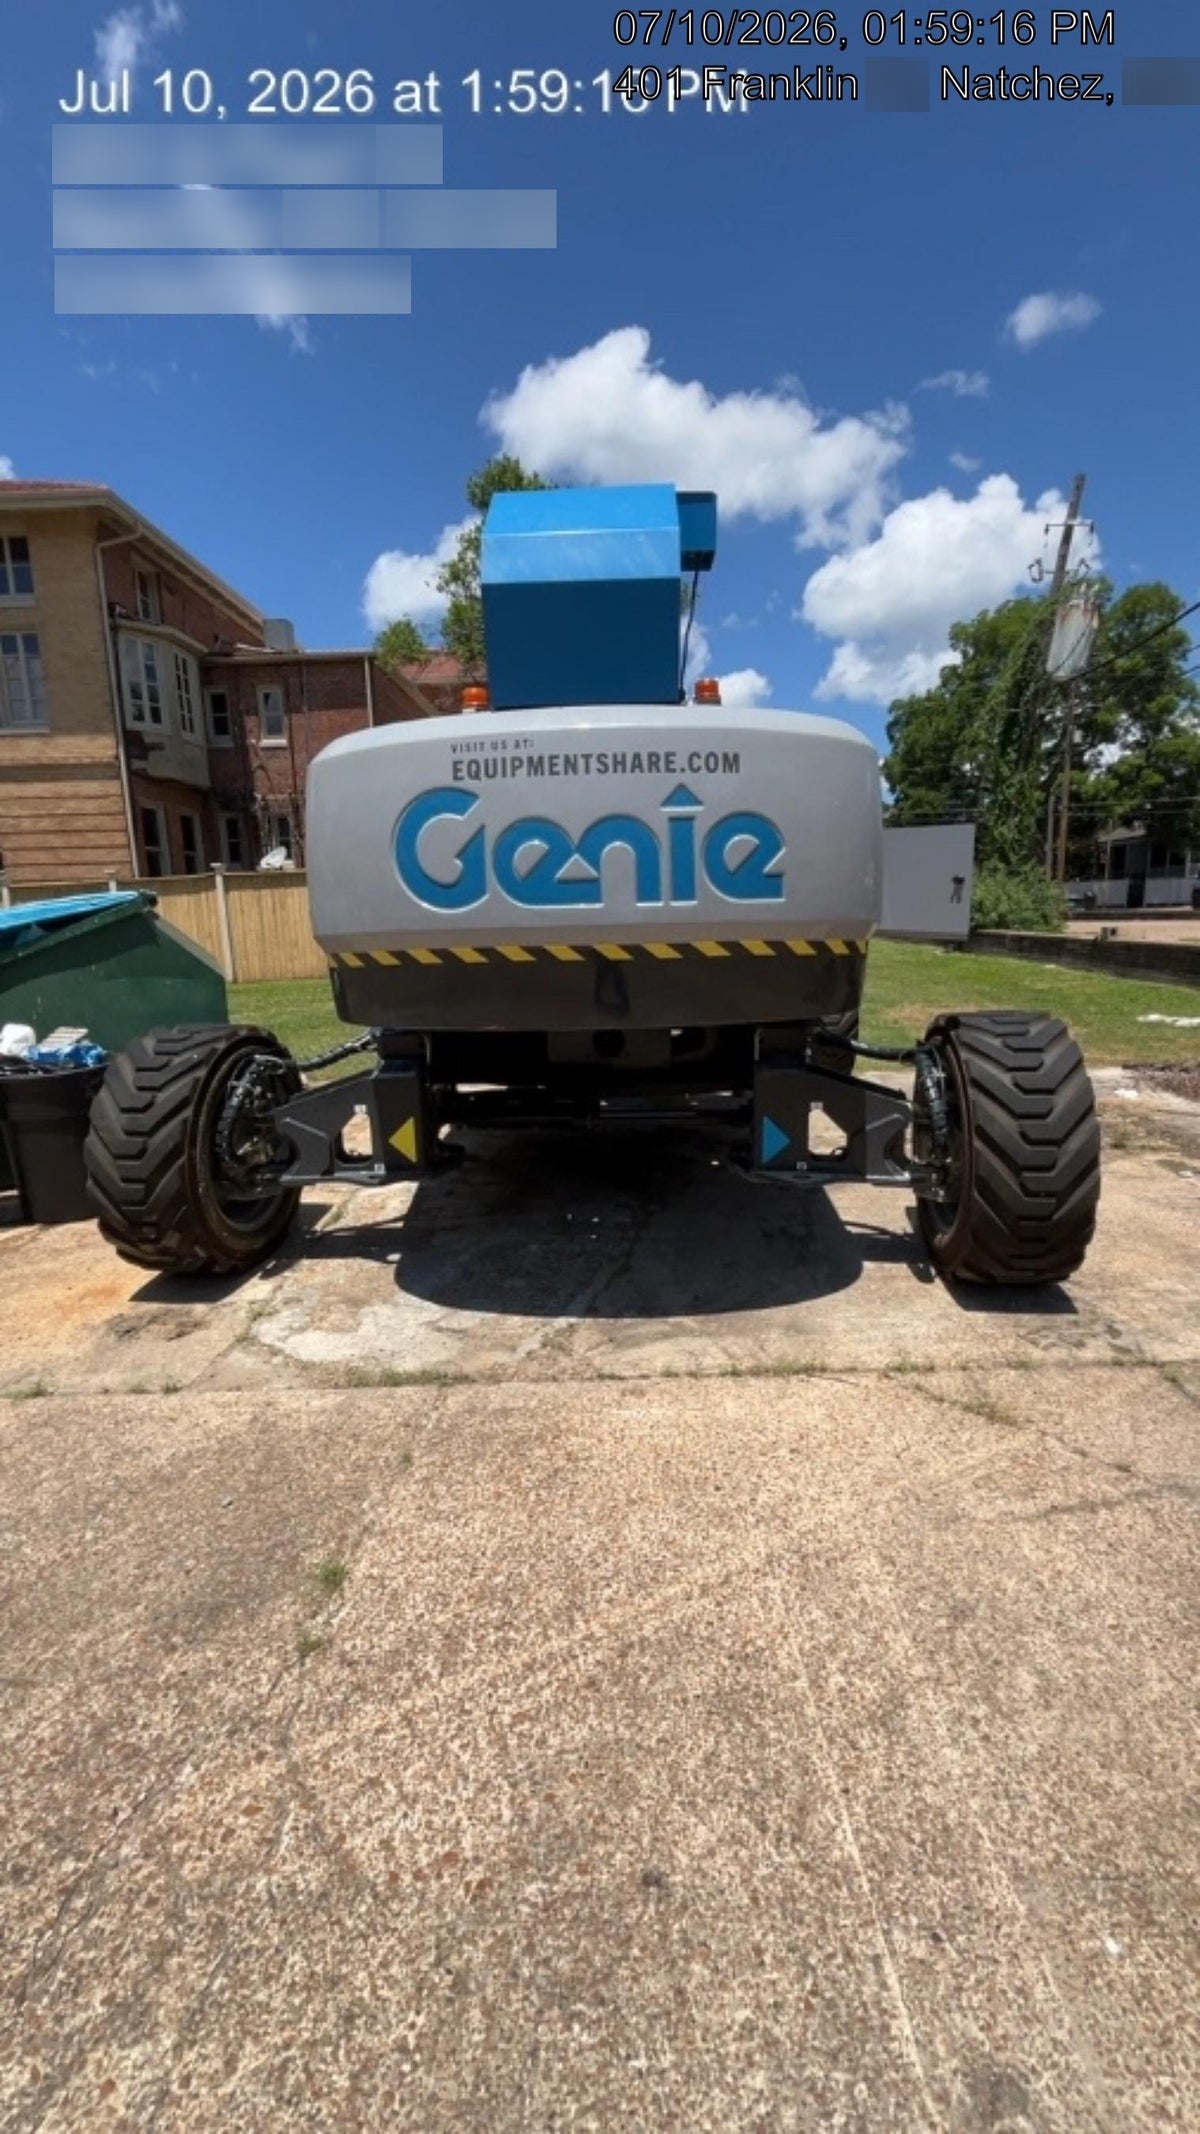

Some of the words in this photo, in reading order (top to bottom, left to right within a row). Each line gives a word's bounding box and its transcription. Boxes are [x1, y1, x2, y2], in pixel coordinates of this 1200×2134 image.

[450, 741, 485, 754] VISIT
[490, 740, 508, 751] US
[513, 739, 535, 751] AT:
[451, 751, 742, 781] EQUIPMENTSHARE.COM
[391, 782, 787, 913] Genie
